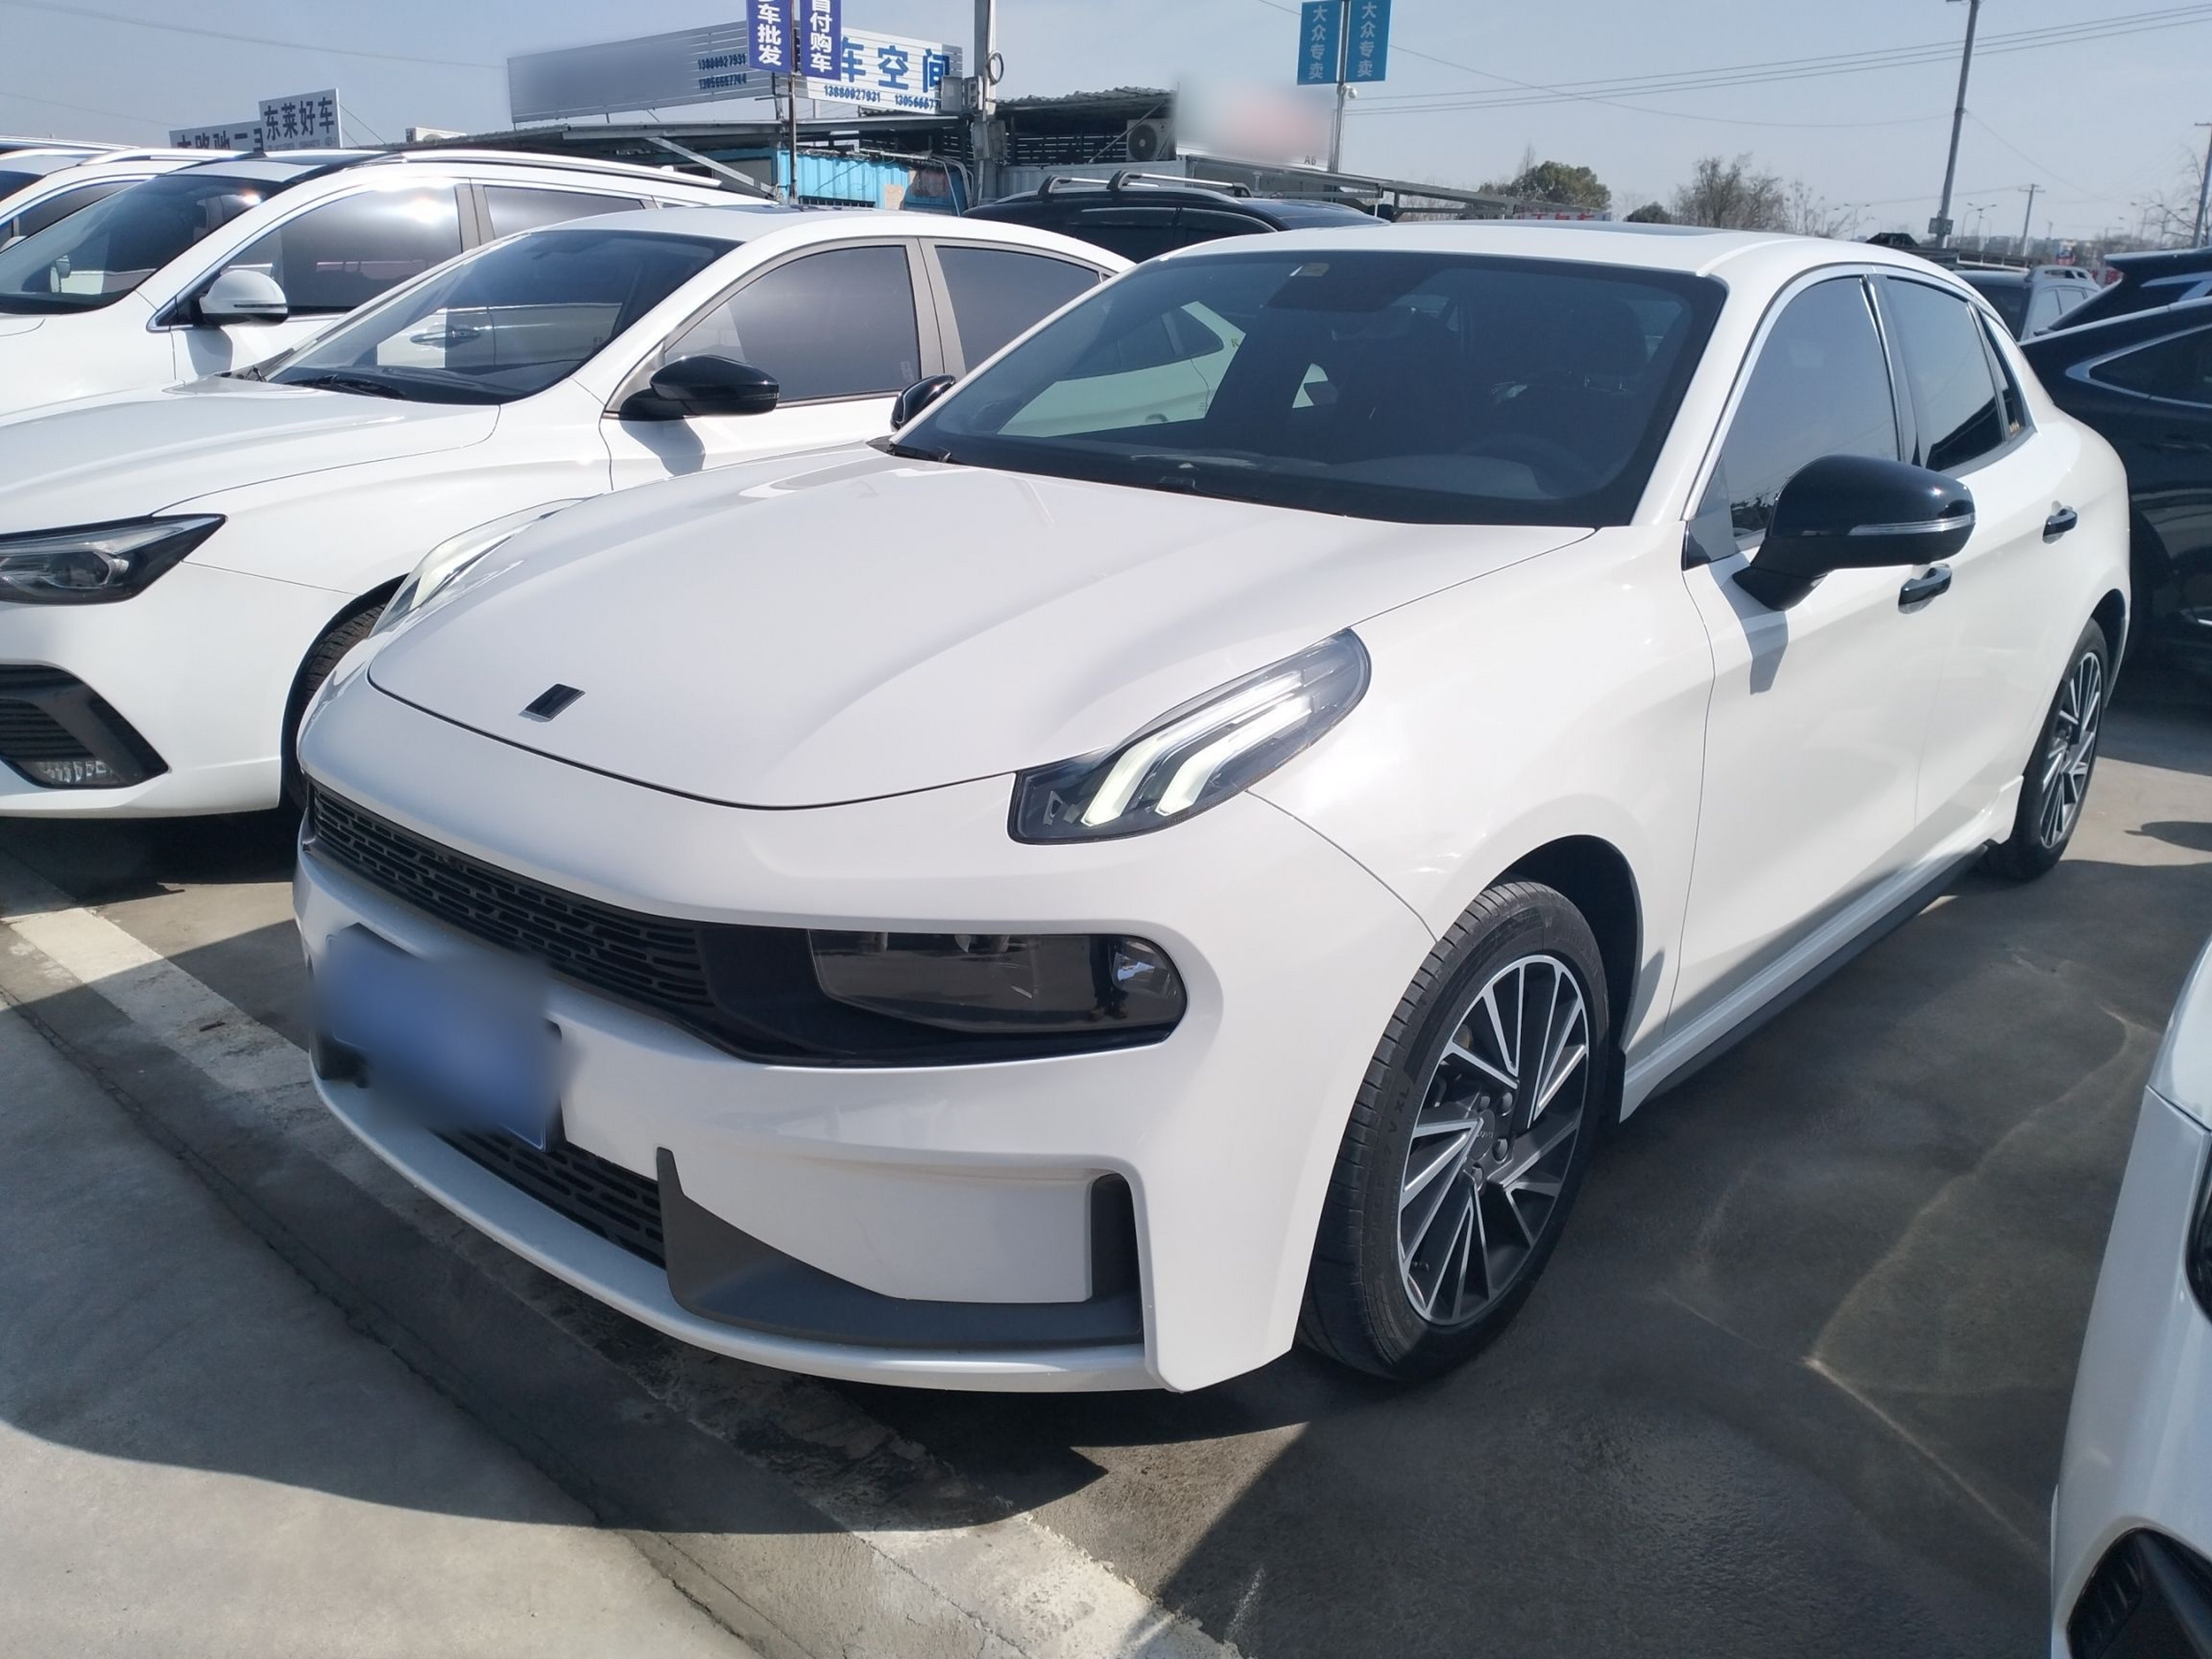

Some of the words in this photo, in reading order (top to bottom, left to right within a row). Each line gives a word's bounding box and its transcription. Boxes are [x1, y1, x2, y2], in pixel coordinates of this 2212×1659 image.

[757, 0, 782, 66] 车批发
[1309, 5, 1328, 79] 大众专卖
[1357, 2, 1377, 78] 大众专卖
[264, 97, 335, 141] 东莱好车
